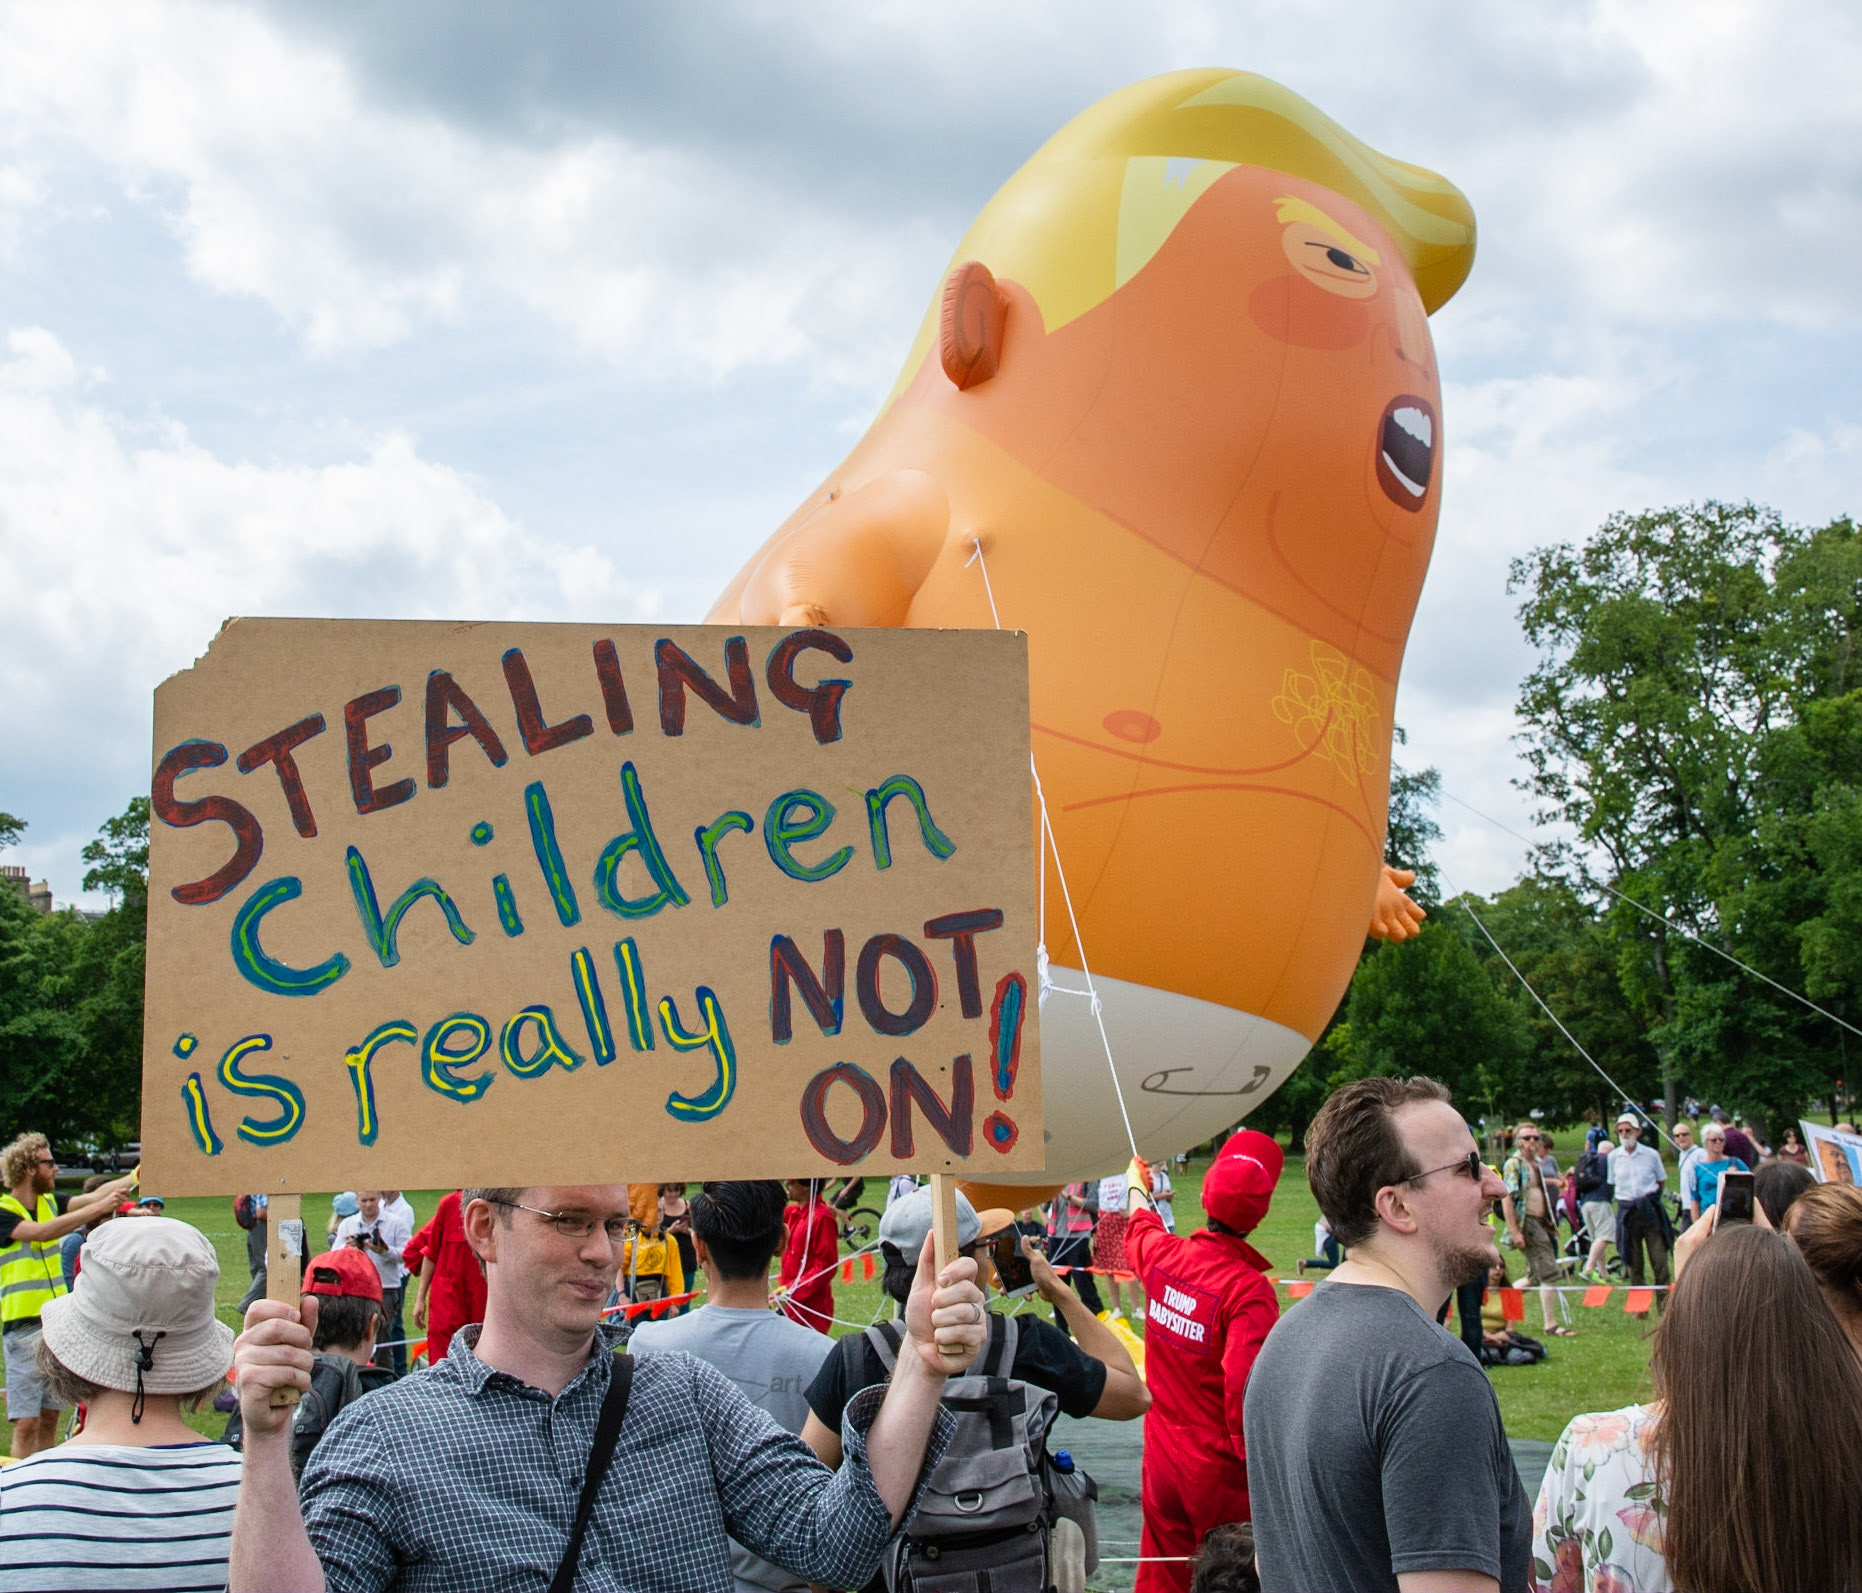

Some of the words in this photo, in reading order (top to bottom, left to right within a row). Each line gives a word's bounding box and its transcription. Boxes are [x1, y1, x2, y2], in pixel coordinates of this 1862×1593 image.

[152, 629, 854, 905] STEALING
[172, 1033, 306, 1156] is
[345, 936, 738, 1147] really
[769, 908, 1004, 1045] NOT
[1148, 1298, 1206, 1342] BABYSITTER
[1163, 1284, 1197, 1316] TRUMP
[769, 1374, 803, 1393] art
